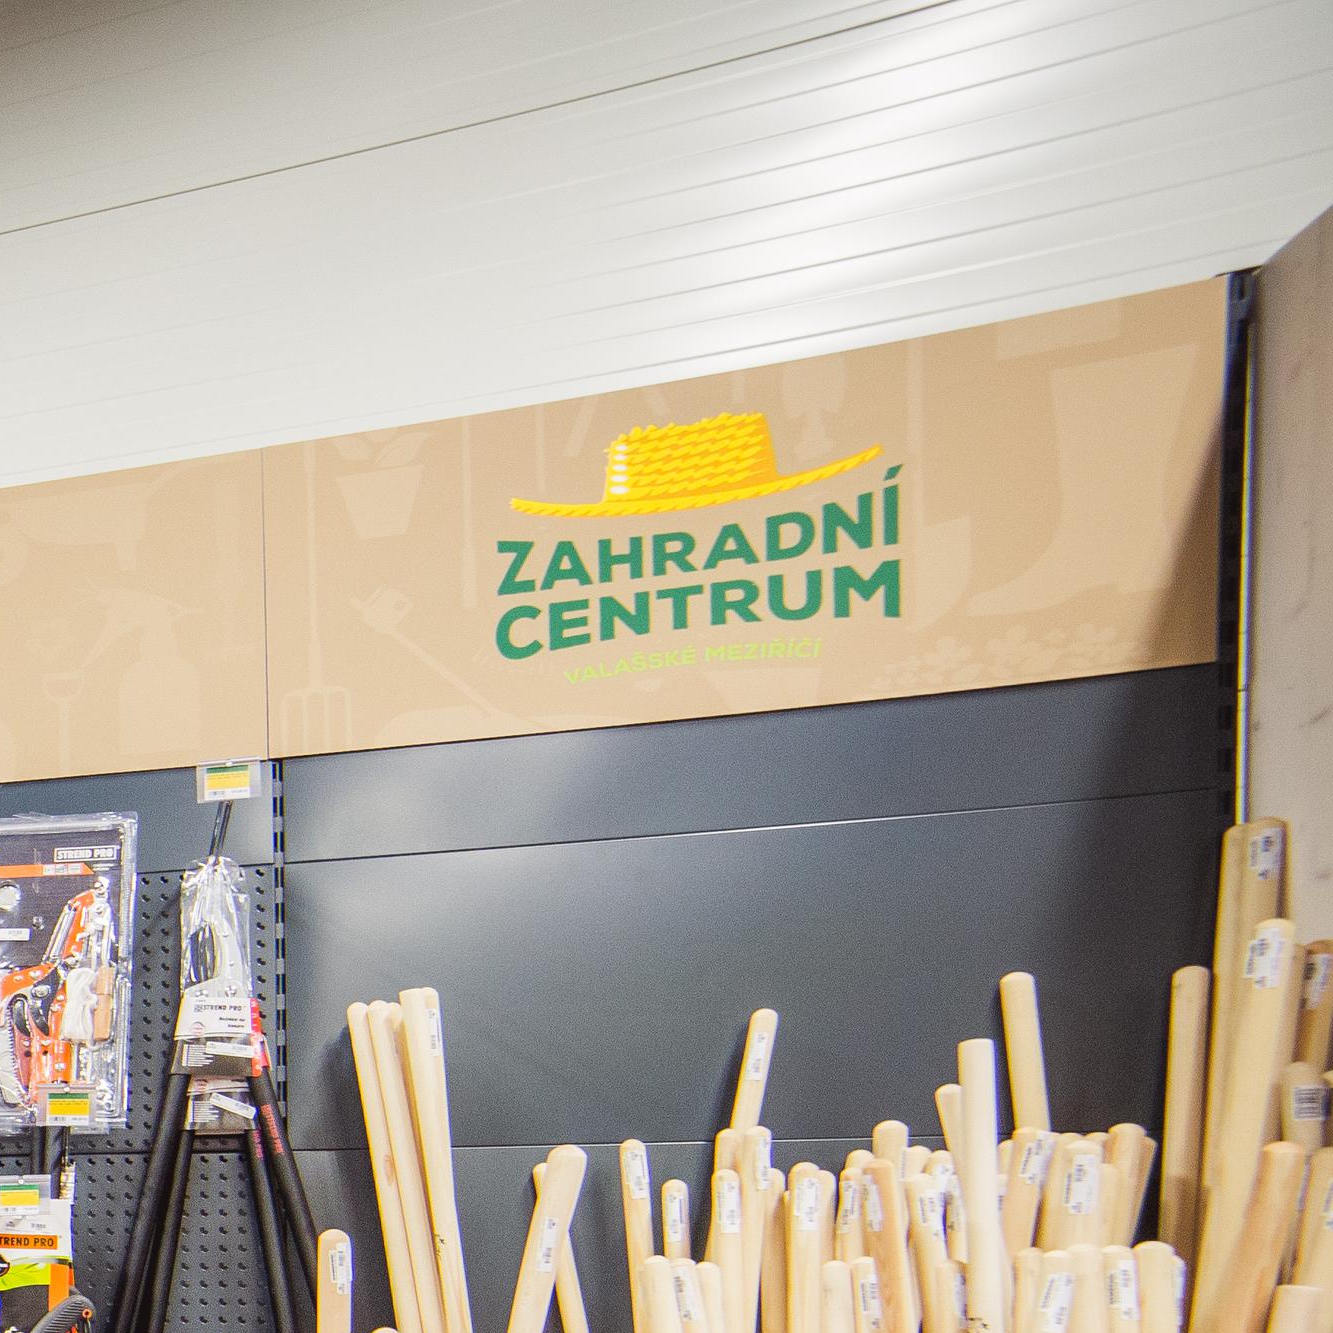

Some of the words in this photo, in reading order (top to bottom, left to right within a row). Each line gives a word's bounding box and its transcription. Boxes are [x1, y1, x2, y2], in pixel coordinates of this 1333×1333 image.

[496, 464, 903, 597] ZAHRADNÍ
[495, 559, 902, 661] CENTRUM
[564, 644, 697, 686] VALAŠSKÉ
[704, 637, 824, 664] MEZIŘÍČÍ
[33, 1237, 54, 1247] PRO
